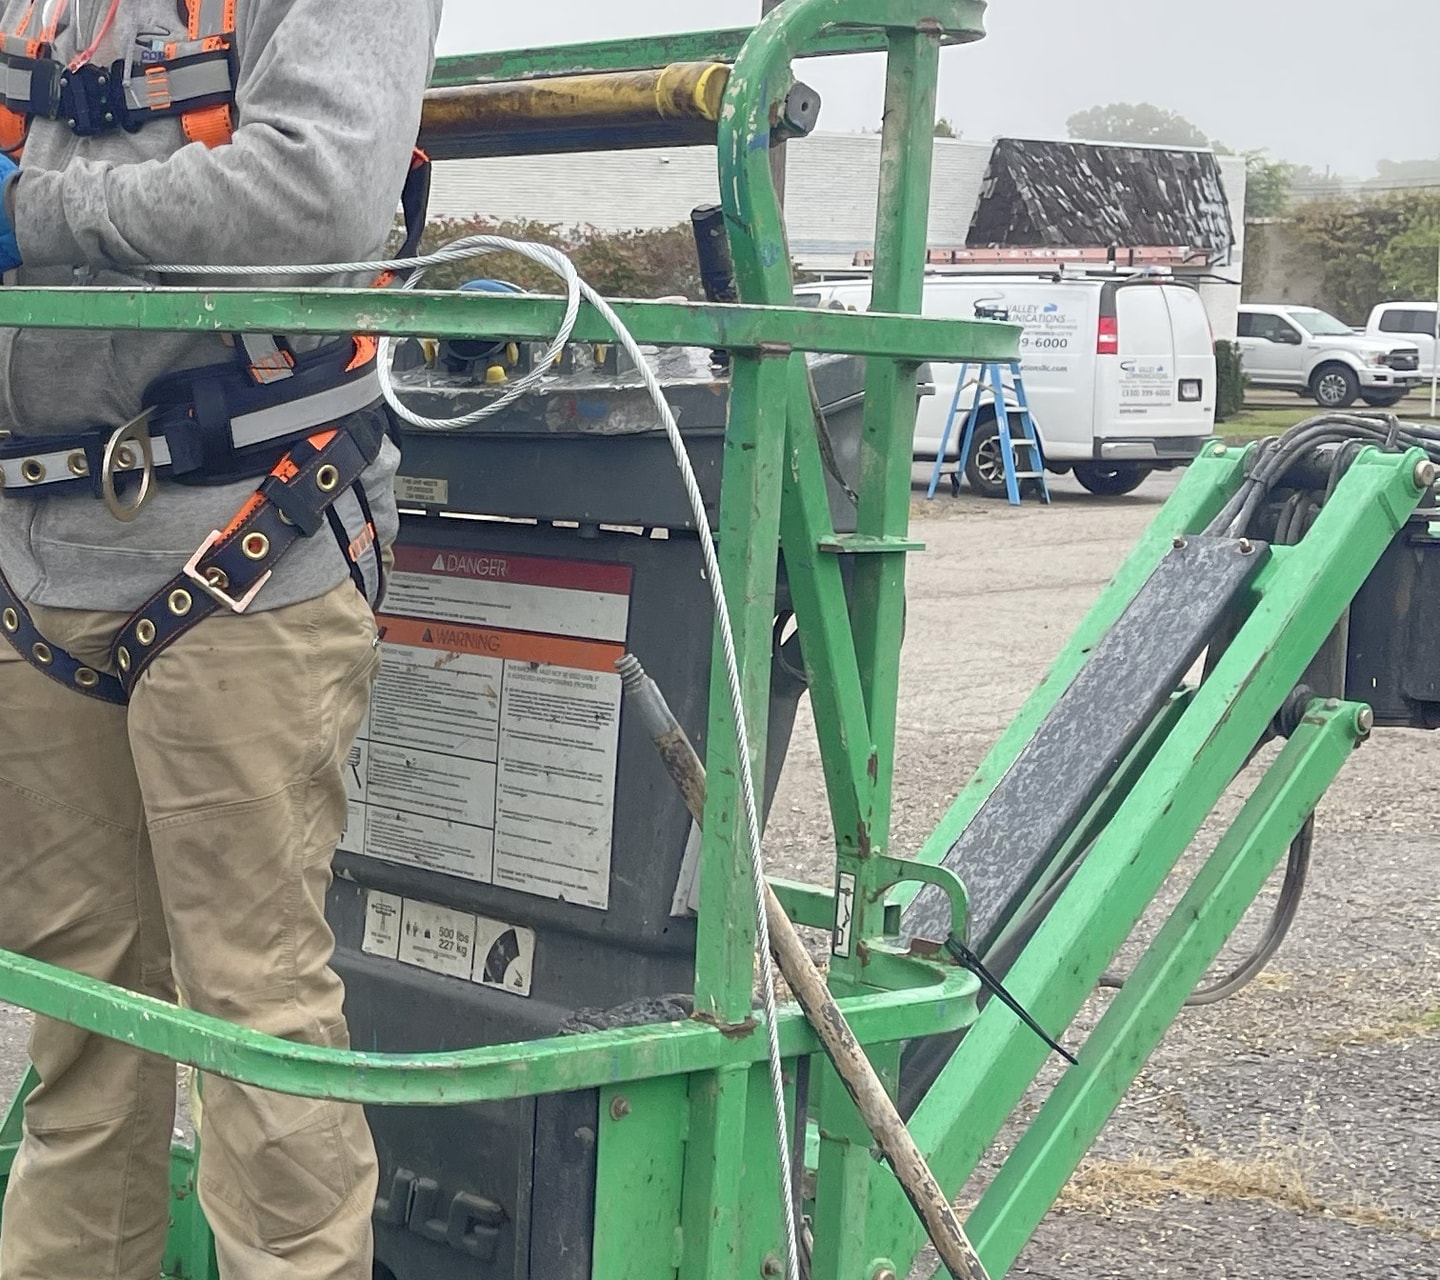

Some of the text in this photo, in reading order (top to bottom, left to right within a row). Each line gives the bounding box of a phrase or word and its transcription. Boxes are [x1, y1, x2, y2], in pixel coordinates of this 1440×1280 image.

[1006, 305, 1039, 313] VALLEY
[1007, 314, 1066, 323] UNICATIONS
[1021, 338, 1068, 348] 9-6000
[447, 554, 508, 577] DANGER
[436, 628, 501, 652] WARNING
[439, 926, 454, 939] 500
[438, 938, 468, 958] 227 kg
